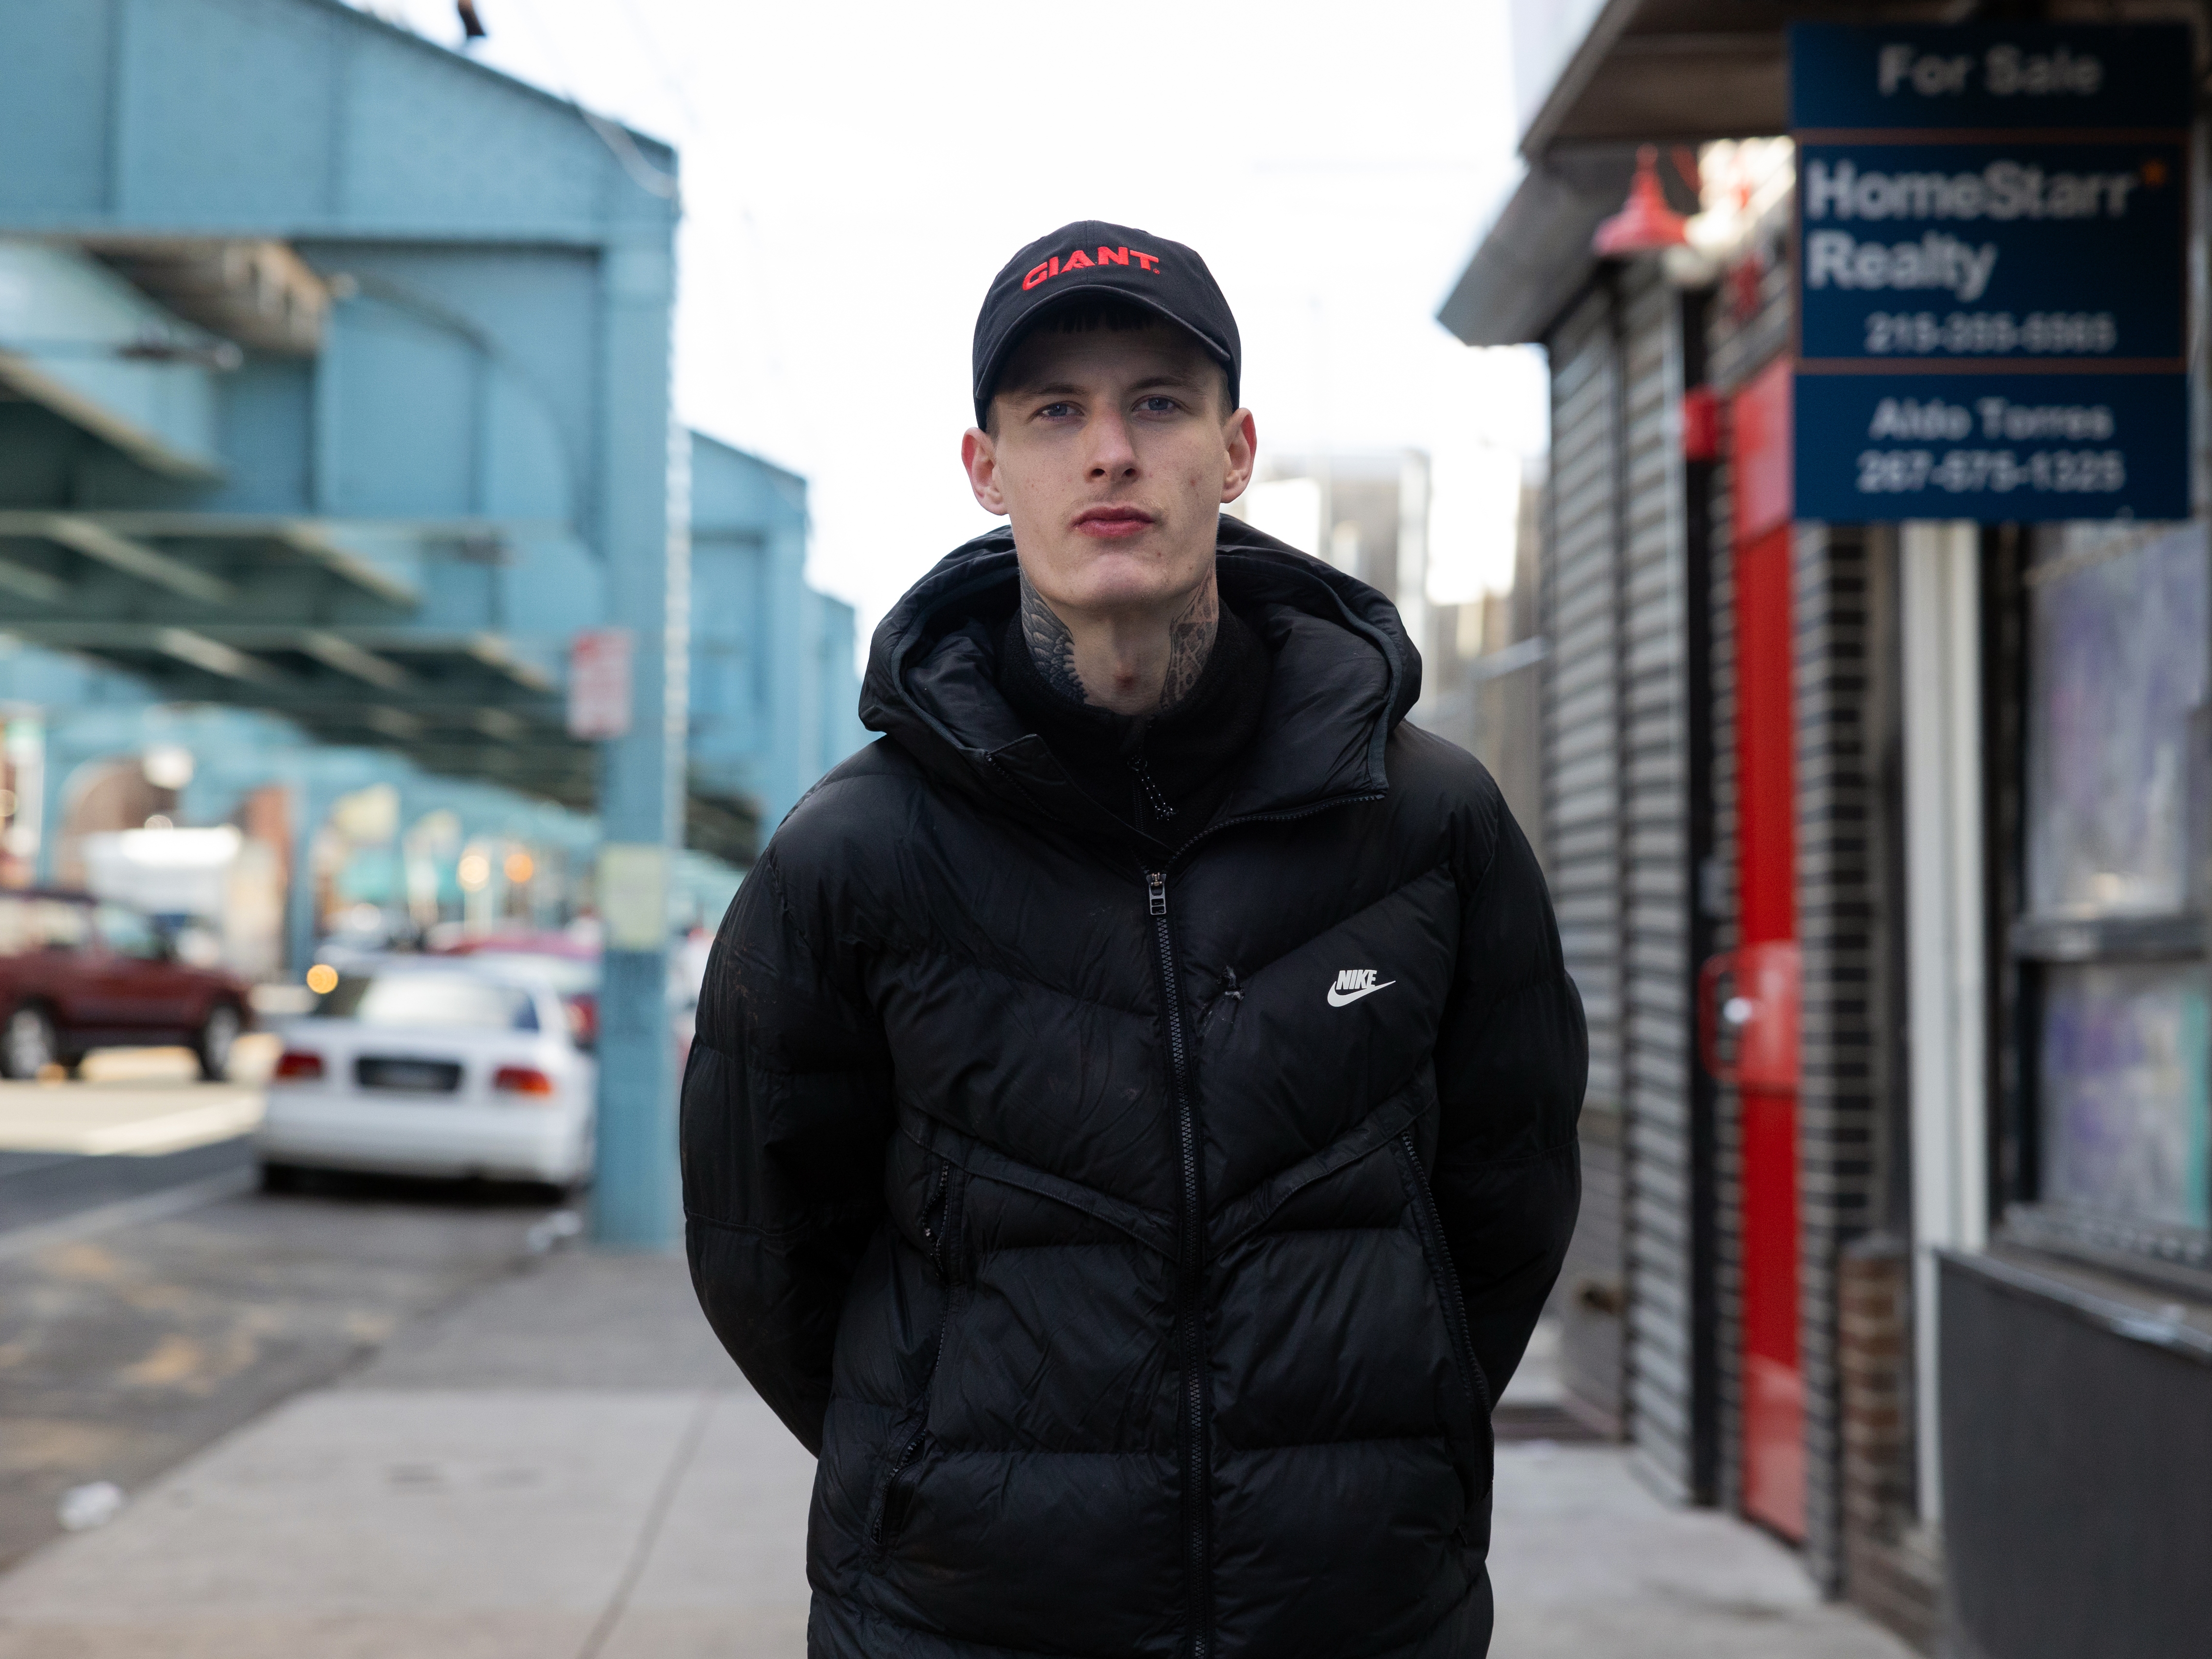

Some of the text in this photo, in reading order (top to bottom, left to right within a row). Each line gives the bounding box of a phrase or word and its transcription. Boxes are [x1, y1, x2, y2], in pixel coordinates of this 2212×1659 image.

[1878, 44, 2103, 95] For Sale
[1806, 160, 2132, 220] HomeStarr
[1022, 246, 1159, 291] GIANT
[1806, 230, 1997, 300] Realty
[1870, 397, 2114, 441] Aldo Torres
[1336, 969, 1377, 990] NIKE
